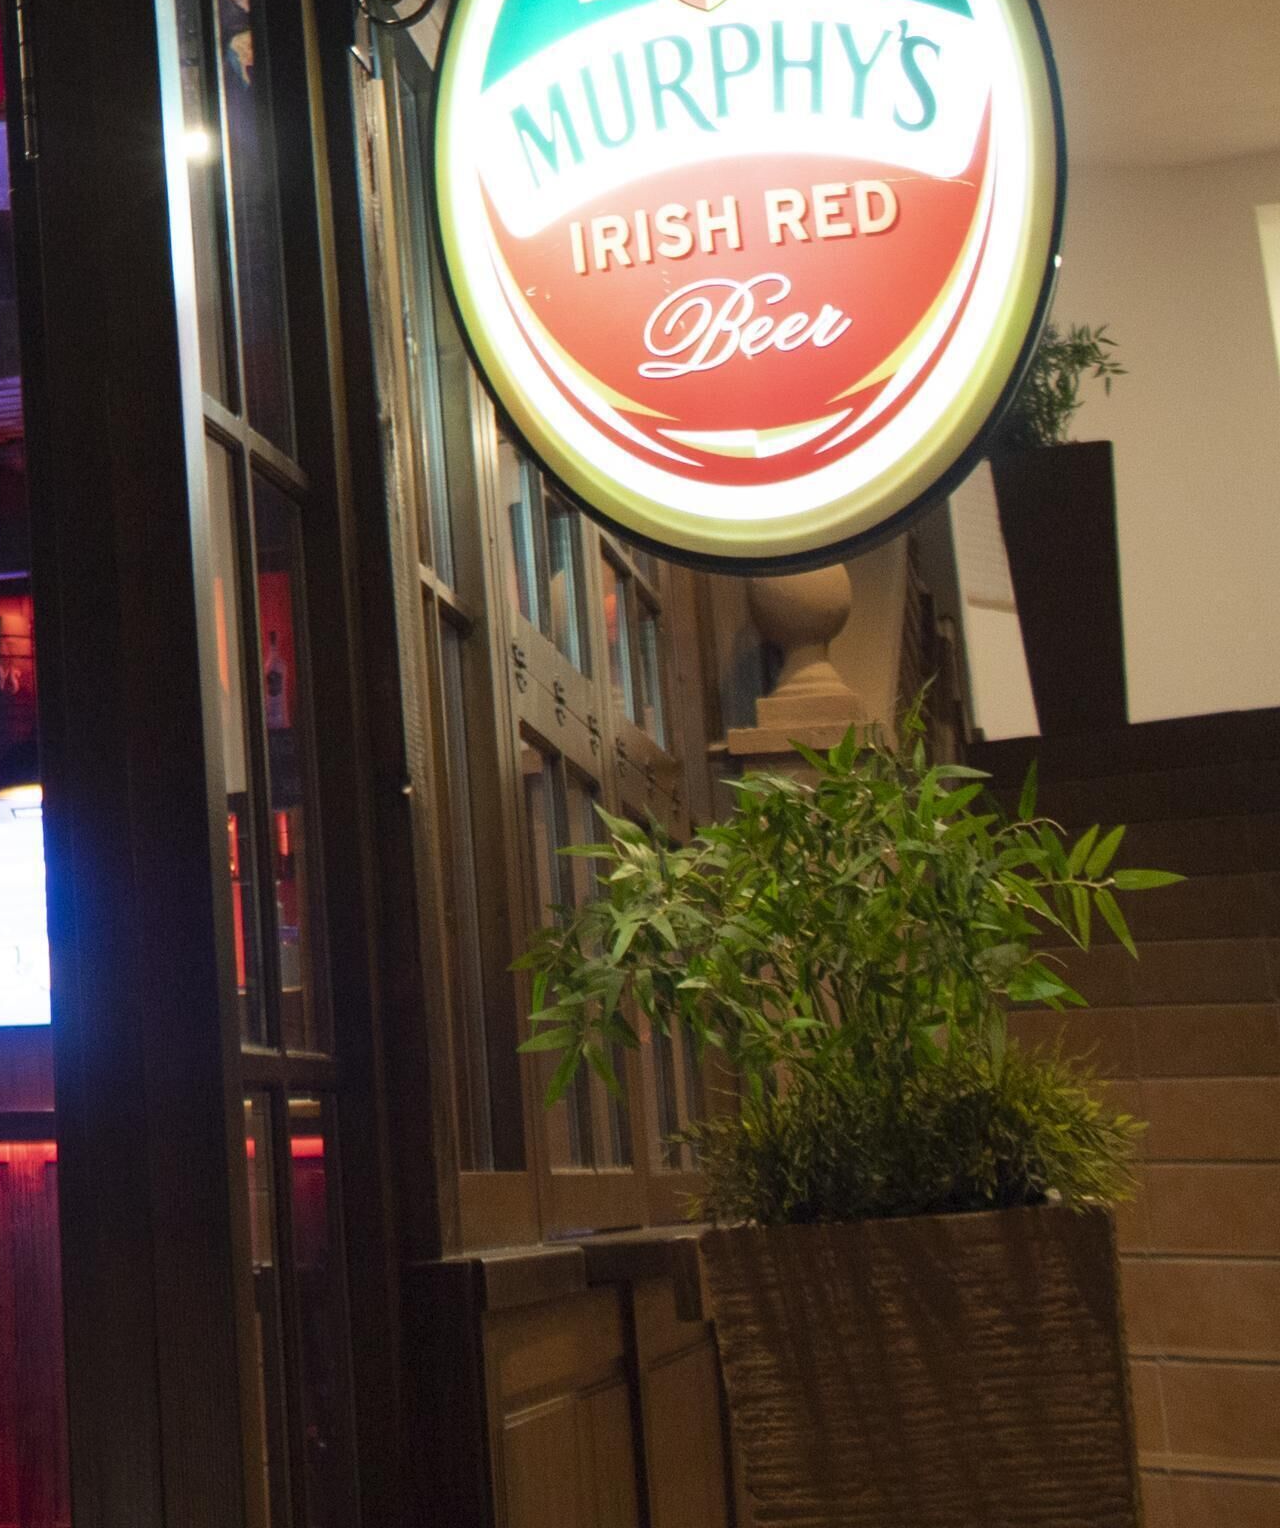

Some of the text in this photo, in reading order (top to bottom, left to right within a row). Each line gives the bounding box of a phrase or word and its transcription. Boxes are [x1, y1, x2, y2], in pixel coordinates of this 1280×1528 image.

[509, 18, 942, 189] MURPHY'S
[569, 179, 901, 275] IRISH RED
[637, 272, 853, 379] Beer
